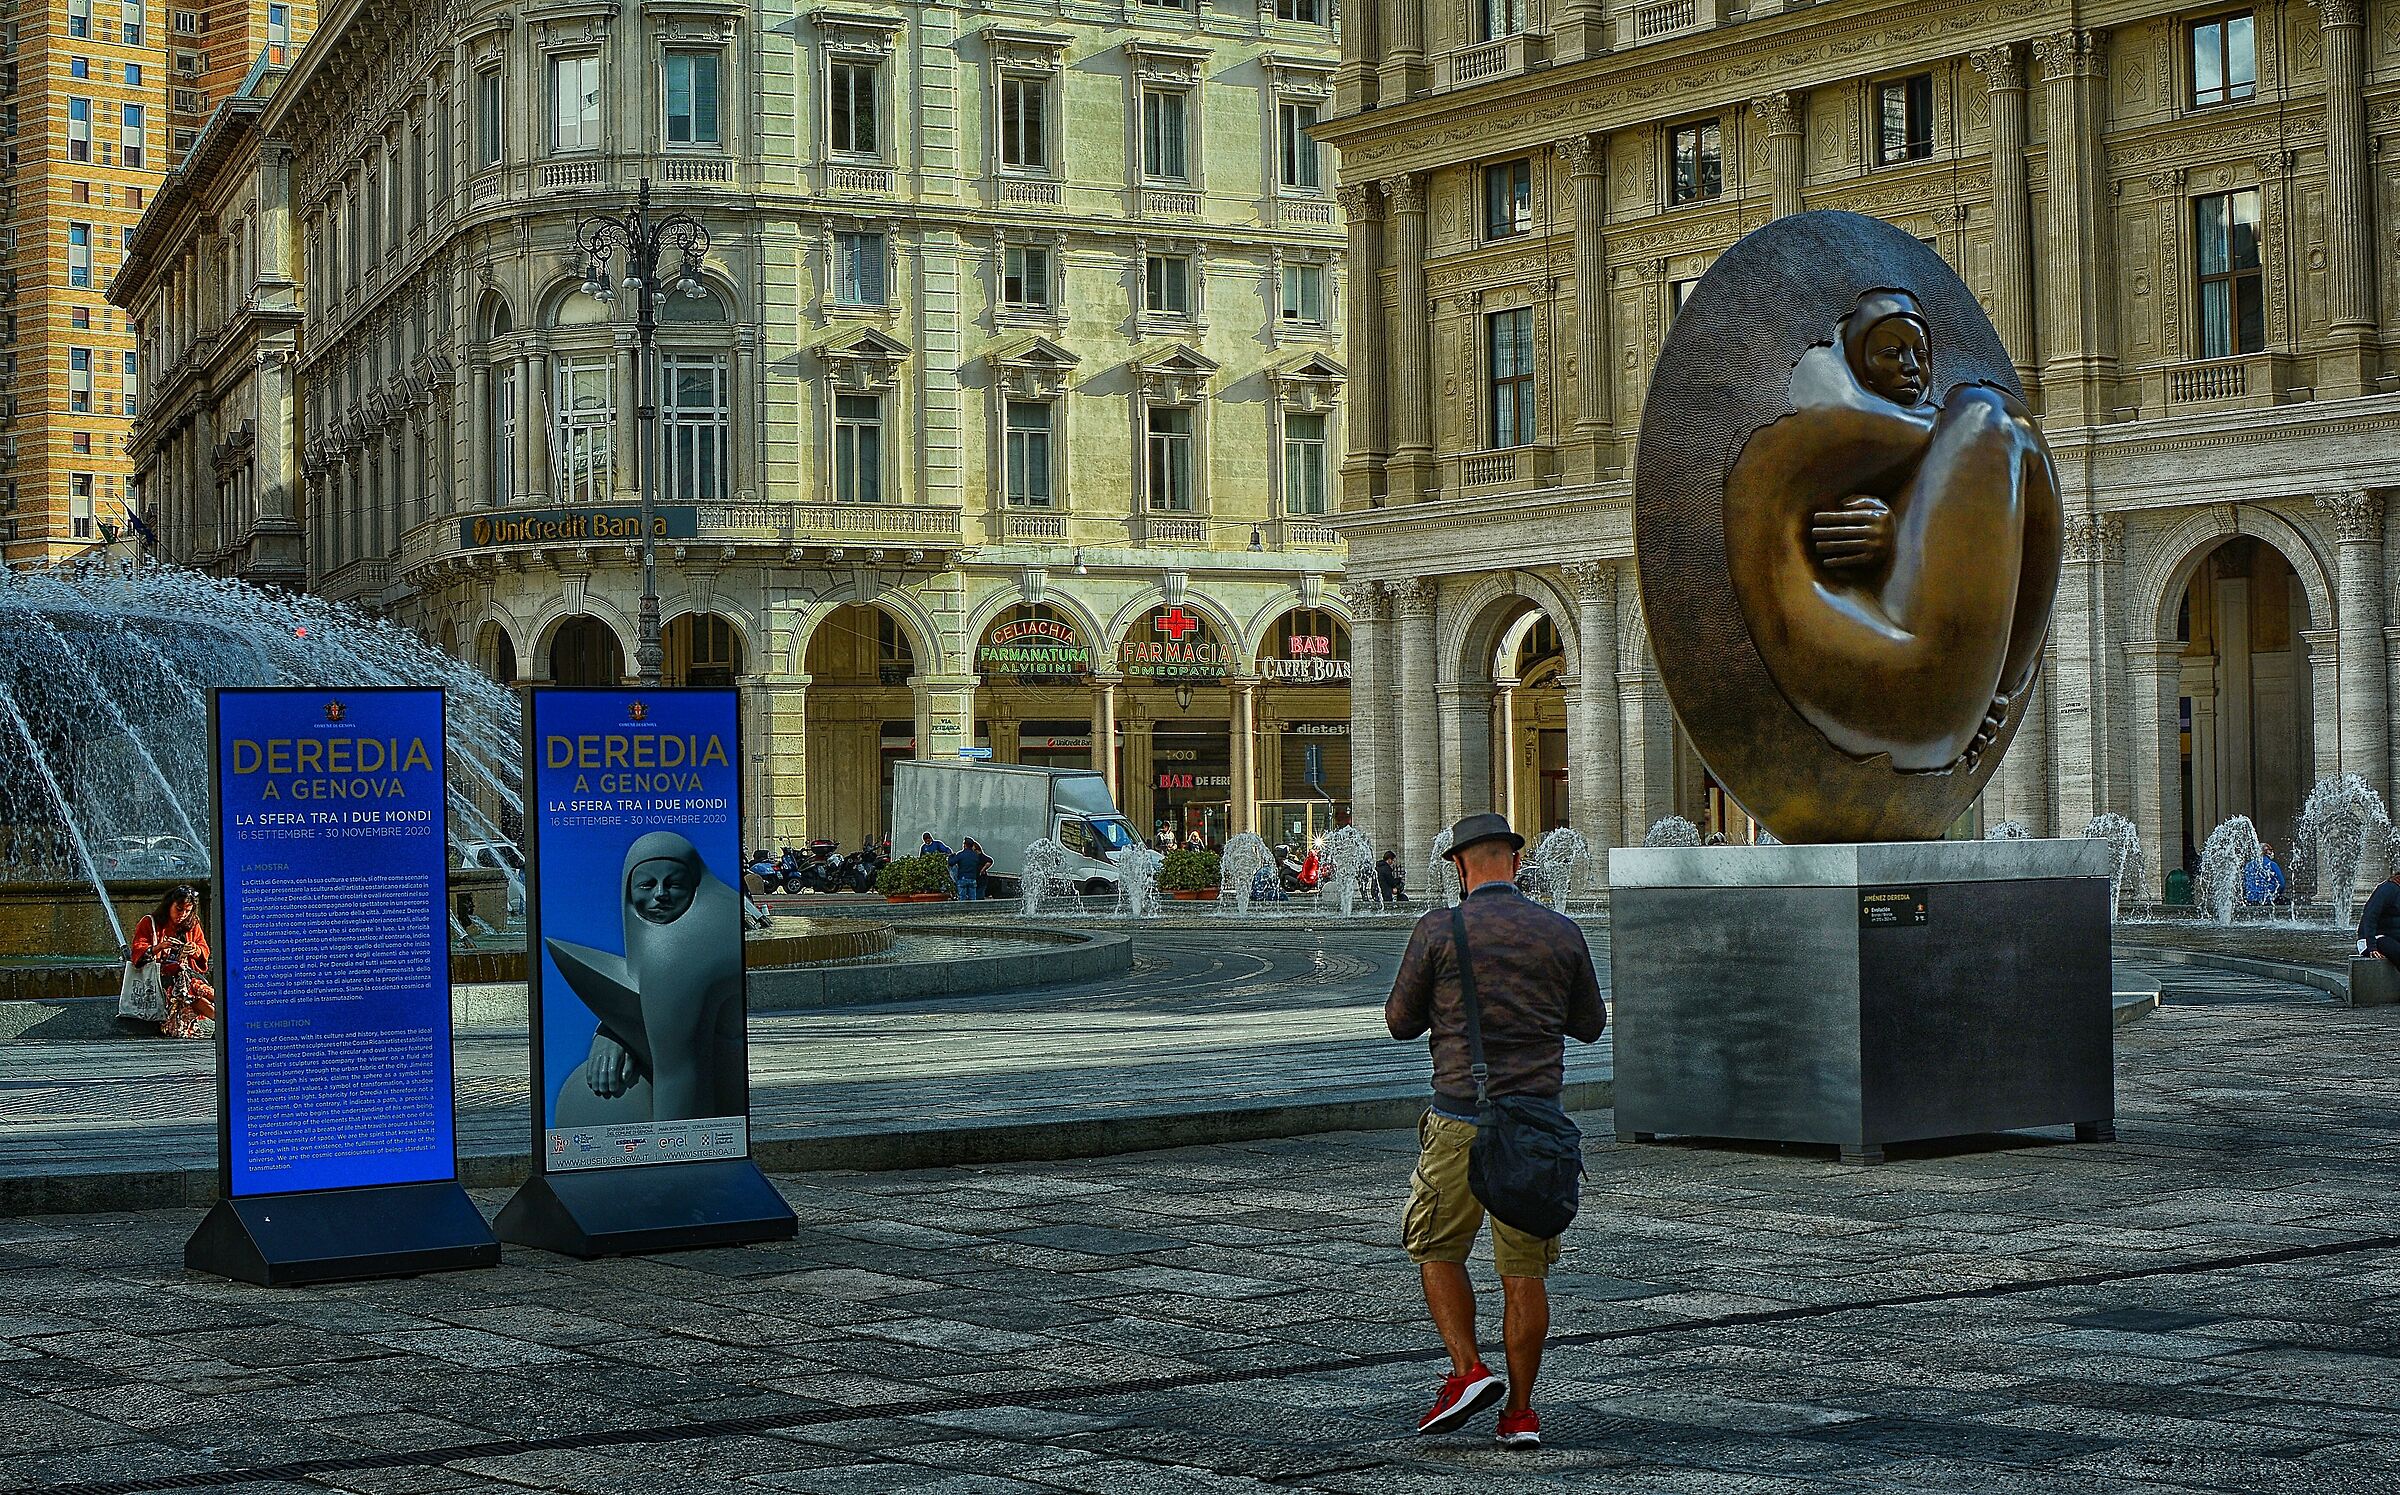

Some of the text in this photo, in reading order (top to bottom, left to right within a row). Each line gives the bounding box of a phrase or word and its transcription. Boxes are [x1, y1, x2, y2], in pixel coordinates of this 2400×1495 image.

[494, 512, 667, 542] UniCredit Bana
[993, 621, 1074, 645] CELIACHIA
[1289, 635, 1329, 654] BAR
[980, 646, 1089, 662] FARMANATURA
[1123, 641, 1231, 663] FARMACIA
[1128, 665, 1226, 676] OMEOPATIA
[1311, 656, 1352, 681] BOAS
[1297, 724, 1350, 735] dieteti
[1056, 738, 1080, 747] UniCredit
[233, 737, 433, 774] DEREDIA
[547, 735, 729, 769] DEREDIA
[573, 772, 704, 794] A GENOVA
[1160, 774, 1194, 788] BAR
[1195, 776, 1209, 786] DE
[262, 778, 405, 800] A GENOVA
[549, 798, 727, 812] LA SFERA TRA I DUE MONDI
[236, 810, 432, 826] LA SFERA TRA I DUE MONDI
[550, 817, 560, 826] 16
[563, 816, 621, 826] SETTEMBRE
[631, 815, 643, 825] 30
[647, 814, 700, 825] NOVEMBRE
[703, 814, 727, 824] 2020
[237, 830, 247, 840] 16
[250, 829, 315, 840] SETTEMBRE
[325, 828, 339, 838] 30
[342, 827, 401, 838] NOVEMBRE
[405, 826, 431, 836] 2020
[241, 863, 290, 872] LA MOSTRA
[1864, 894, 1886, 902] JIMÉNEZ
[245, 1019, 311, 1030] THE EXHIBITION
[658, 1135, 688, 1149] enel
[663, 1147, 737, 1160] WWW.VISITGENOA.IT
